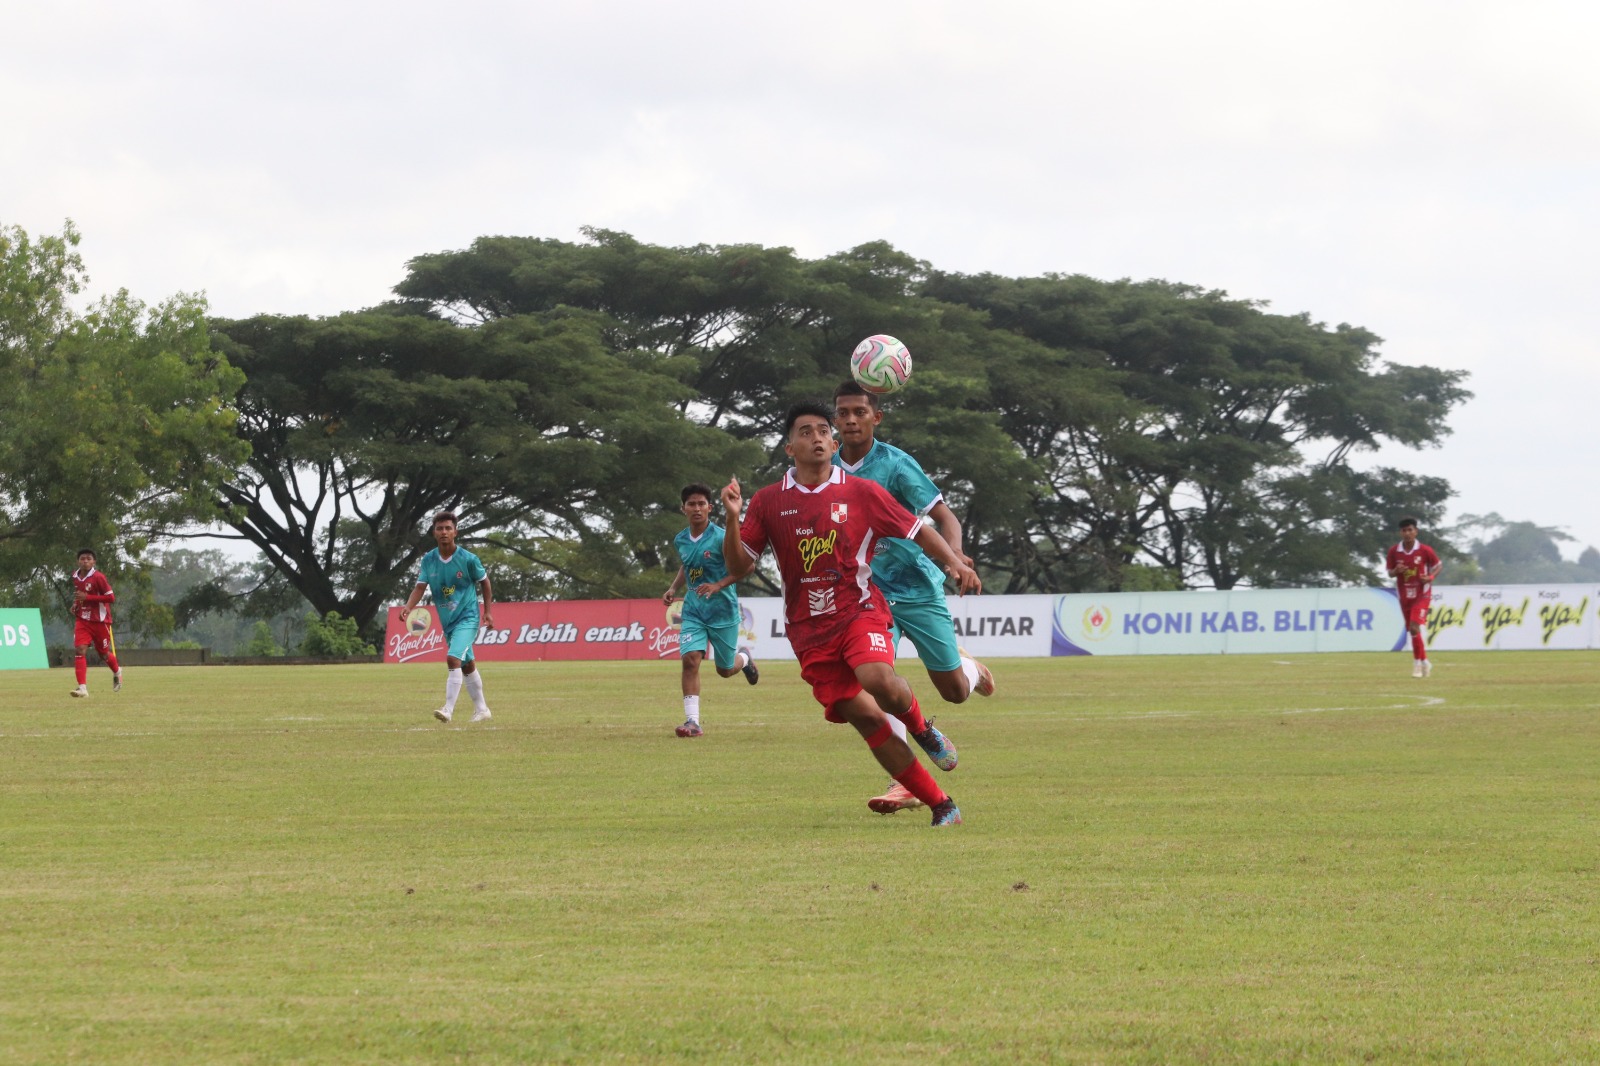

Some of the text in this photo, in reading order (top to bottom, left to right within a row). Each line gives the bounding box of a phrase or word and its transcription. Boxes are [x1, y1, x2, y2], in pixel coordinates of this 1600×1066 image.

[795, 527, 814, 536] Kopi
[1480, 591, 1501, 601] Kopi
[1538, 590, 1560, 600] Kopi
[1123, 609, 1375, 635] KONI KAB. BLITAR
[0, 624, 31, 647] DS
[515, 623, 578, 644] lebih
[584, 621, 646, 643] enak
[867, 632, 887, 648] 18
